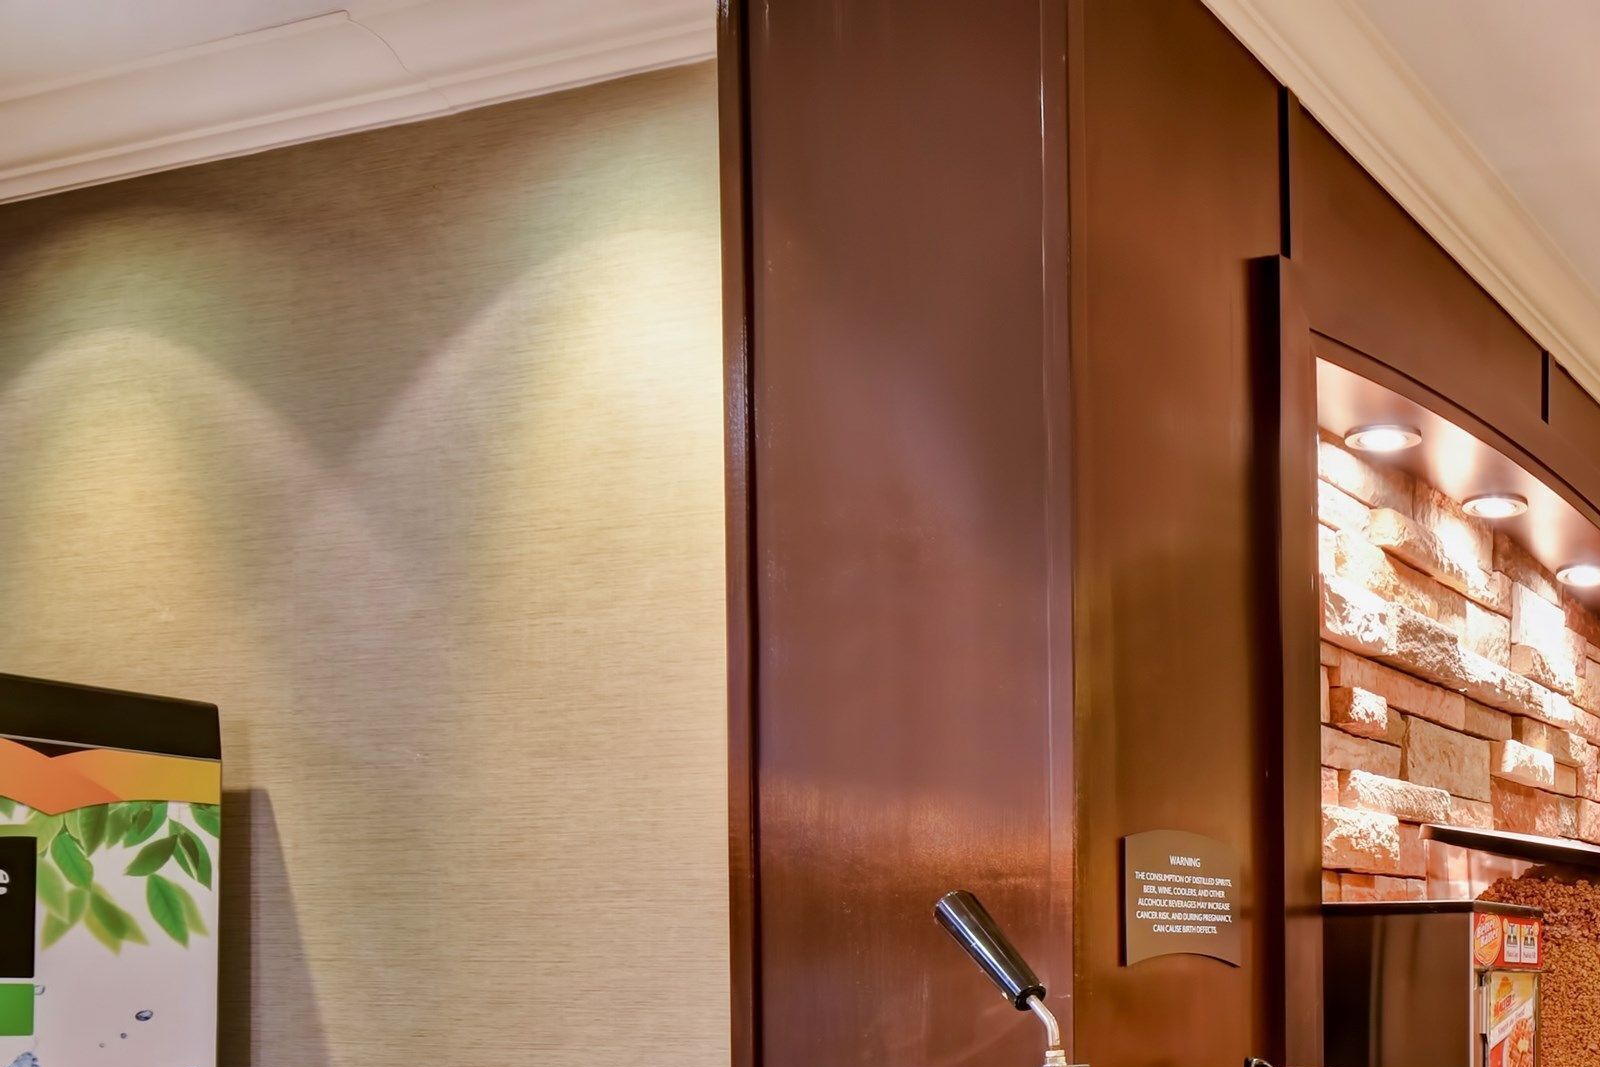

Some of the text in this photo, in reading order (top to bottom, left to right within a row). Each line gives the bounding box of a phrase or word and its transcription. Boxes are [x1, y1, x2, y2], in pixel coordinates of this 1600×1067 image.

[1135, 871, 1146, 880] THE
[1146, 872, 1184, 883] CONSUMPTION
[1192, 877, 1214, 886] DISTILLED
[1198, 889, 1209, 898] AND
[1209, 890, 1225, 898] OTHER
[1138, 898, 1230, 911] ALCOHOLIC BEVERAGES MAY INCREASE
[1136, 911, 1157, 919] CANCER
[1171, 913, 1182, 921] AND
[1183, 913, 1202, 921] DURING
[1153, 924, 1165, 933] CAN
[1165, 924, 1182, 933] CAUSE
